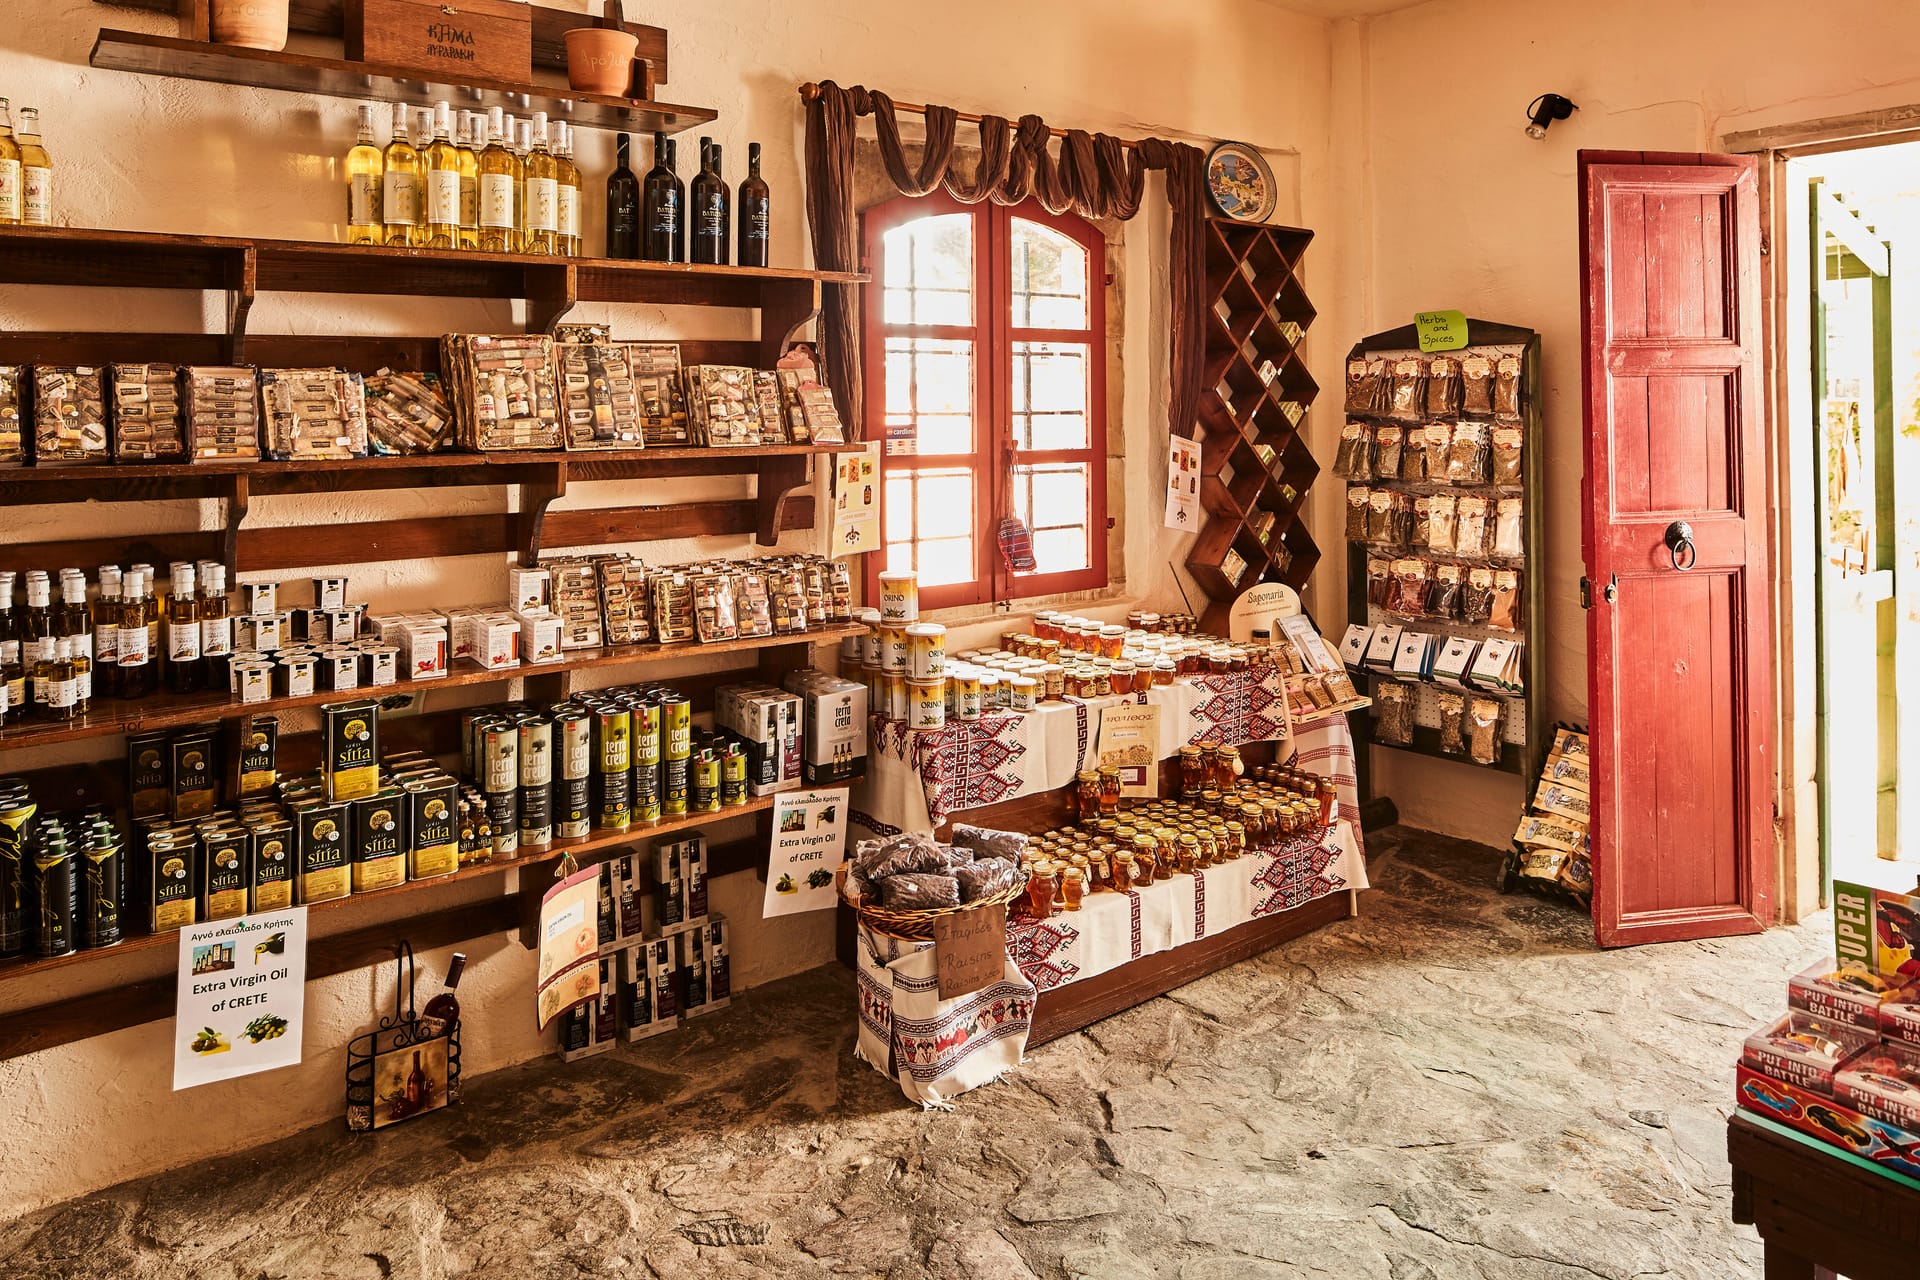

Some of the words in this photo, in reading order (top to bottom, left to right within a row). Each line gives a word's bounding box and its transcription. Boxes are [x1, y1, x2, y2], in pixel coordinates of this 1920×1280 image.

[1419, 315, 1447, 325] Herbs
[1433, 324, 1448, 332] and
[1422, 334, 1455, 347] Spices
[883, 594, 905, 602] ORINO
[1247, 589, 1284, 605] Saponaria
[836, 705, 851, 717] terra
[920, 701, 941, 709] ORINO
[835, 716, 851, 728] creta
[638, 734, 658, 747] terra
[670, 728, 689, 741] terra
[605, 740, 627, 753] terra
[637, 746, 658, 759] creta
[670, 740, 689, 753] creta
[492, 757, 514, 772] terra
[524, 753, 546, 766] terra
[605, 752, 627, 765] creta
[491, 771, 514, 786] creta
[523, 766, 546, 779] creta
[779, 839, 799, 848] Extra
[801, 835, 823, 847] Virgin
[825, 833, 836, 842] Oil
[789, 853, 799, 863] of
[800, 851, 823, 861] CRETE
[191, 929, 214, 942] Αγνό
[215, 923, 262, 938] ελαιόλαδο
[263, 917, 294, 931] Κρήτης
[1837, 893, 1868, 973] SUPER
[944, 950, 993, 971] Raisins
[192, 980, 226, 995] Extra
[230, 972, 267, 988] Virgin
[270, 968, 288, 980] Oil
[944, 975, 980, 993] Raisins
[211, 999, 226, 1012] of
[229, 992, 268, 1010] CRETE
[1803, 989, 1828, 1004] PUT
[1833, 997, 1863, 1014] INTO
[1809, 1001, 1856, 1024] BATTLE
[1758, 1050, 1781, 1067] PUT
[1787, 1060, 1817, 1078] INTO
[1764, 1064, 1811, 1088] BATTLE
[1850, 1088, 1877, 1105] PUT
[1883, 1099, 1917, 1121] INTO
[1857, 1102, 1908, 1129] BATTLE
